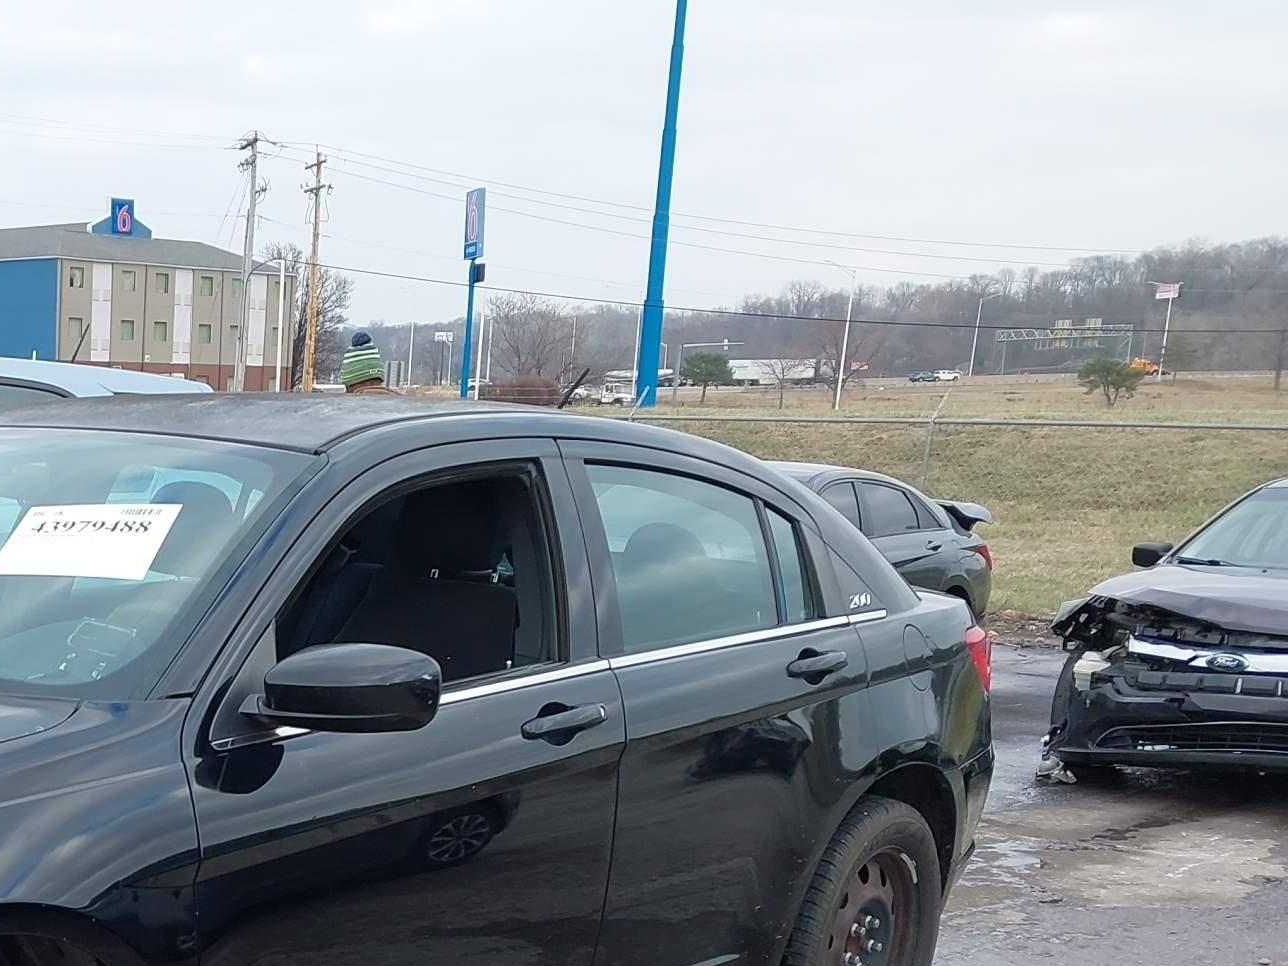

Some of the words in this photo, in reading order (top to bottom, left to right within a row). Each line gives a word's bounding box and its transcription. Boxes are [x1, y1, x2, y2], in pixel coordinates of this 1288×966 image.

[117, 204, 131, 233] 6
[469, 191, 478, 241] 6
[32, 520, 152, 534] 43979488
[1213, 656, 1239, 668] Ford
